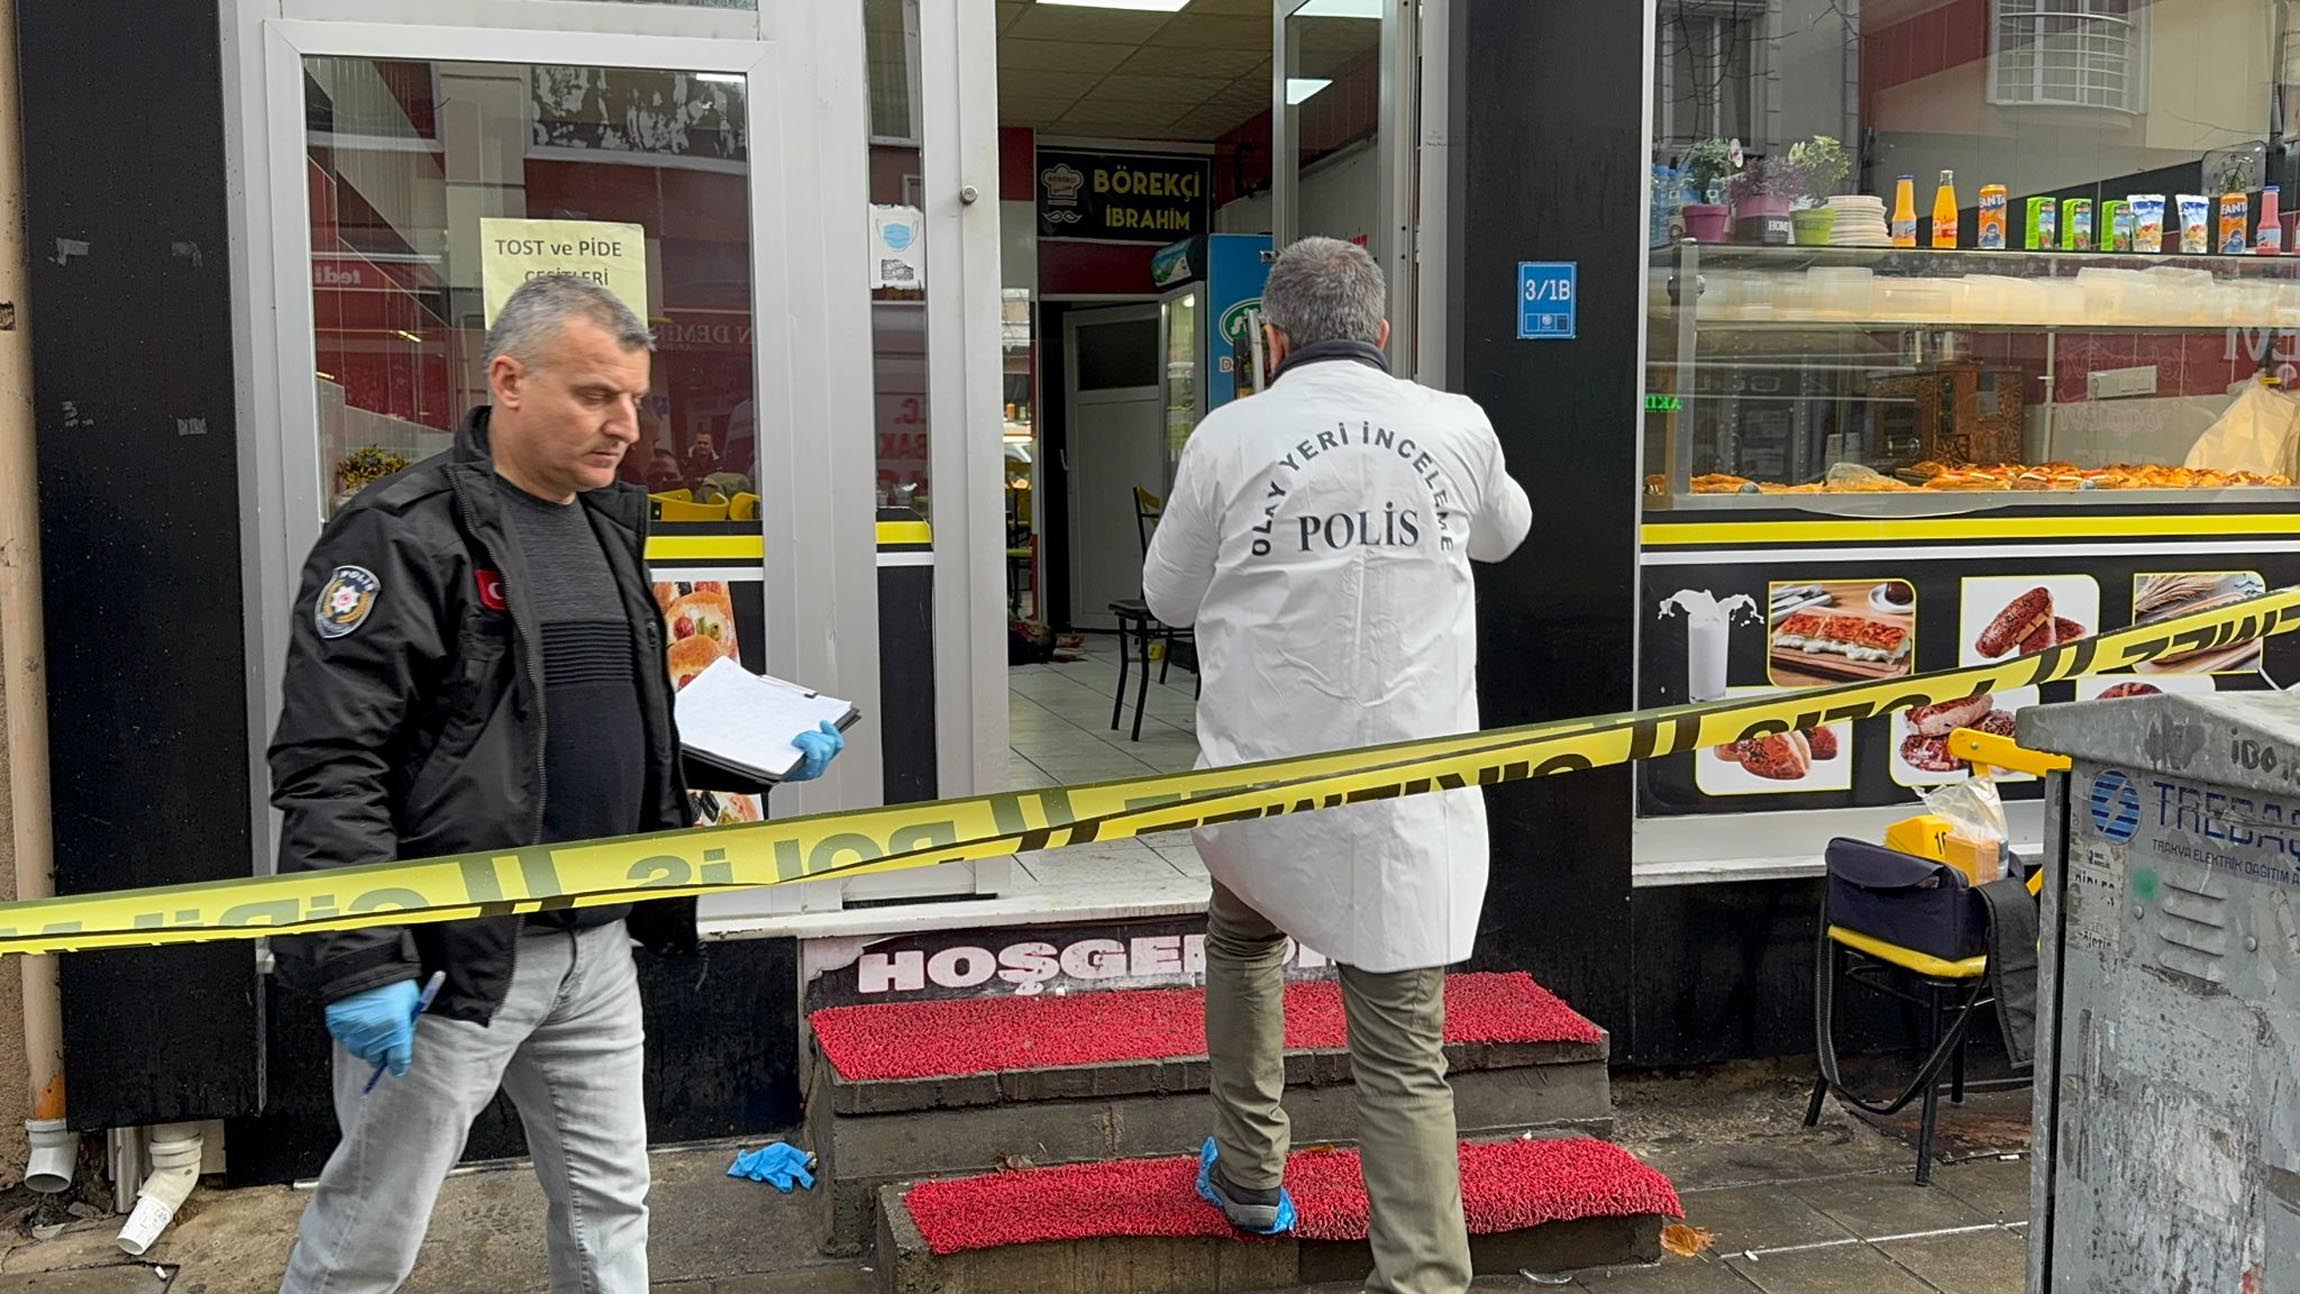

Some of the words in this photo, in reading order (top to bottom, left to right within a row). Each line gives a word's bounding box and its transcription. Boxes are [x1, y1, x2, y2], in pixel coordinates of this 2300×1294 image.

[1093, 164, 1200, 202] BÖREKÇİ
[1105, 204, 1191, 231] İBRAHİM
[494, 239, 545, 256] TOST
[550, 243, 573, 256] ve
[578, 237, 623, 257] PİDE
[1525, 279, 1571, 301] 3/1B
[1251, 480, 1287, 557] OLAY
[1278, 422, 1349, 473] YERİ
[1362, 420, 1454, 552] İNCELEME
[1296, 501, 1420, 552] POLİS
[2152, 838, 2192, 858] TRAKYA
[2193, 849, 2243, 872] ELEKTRİK
[2244, 861, 2290, 883] DAĞITIM
